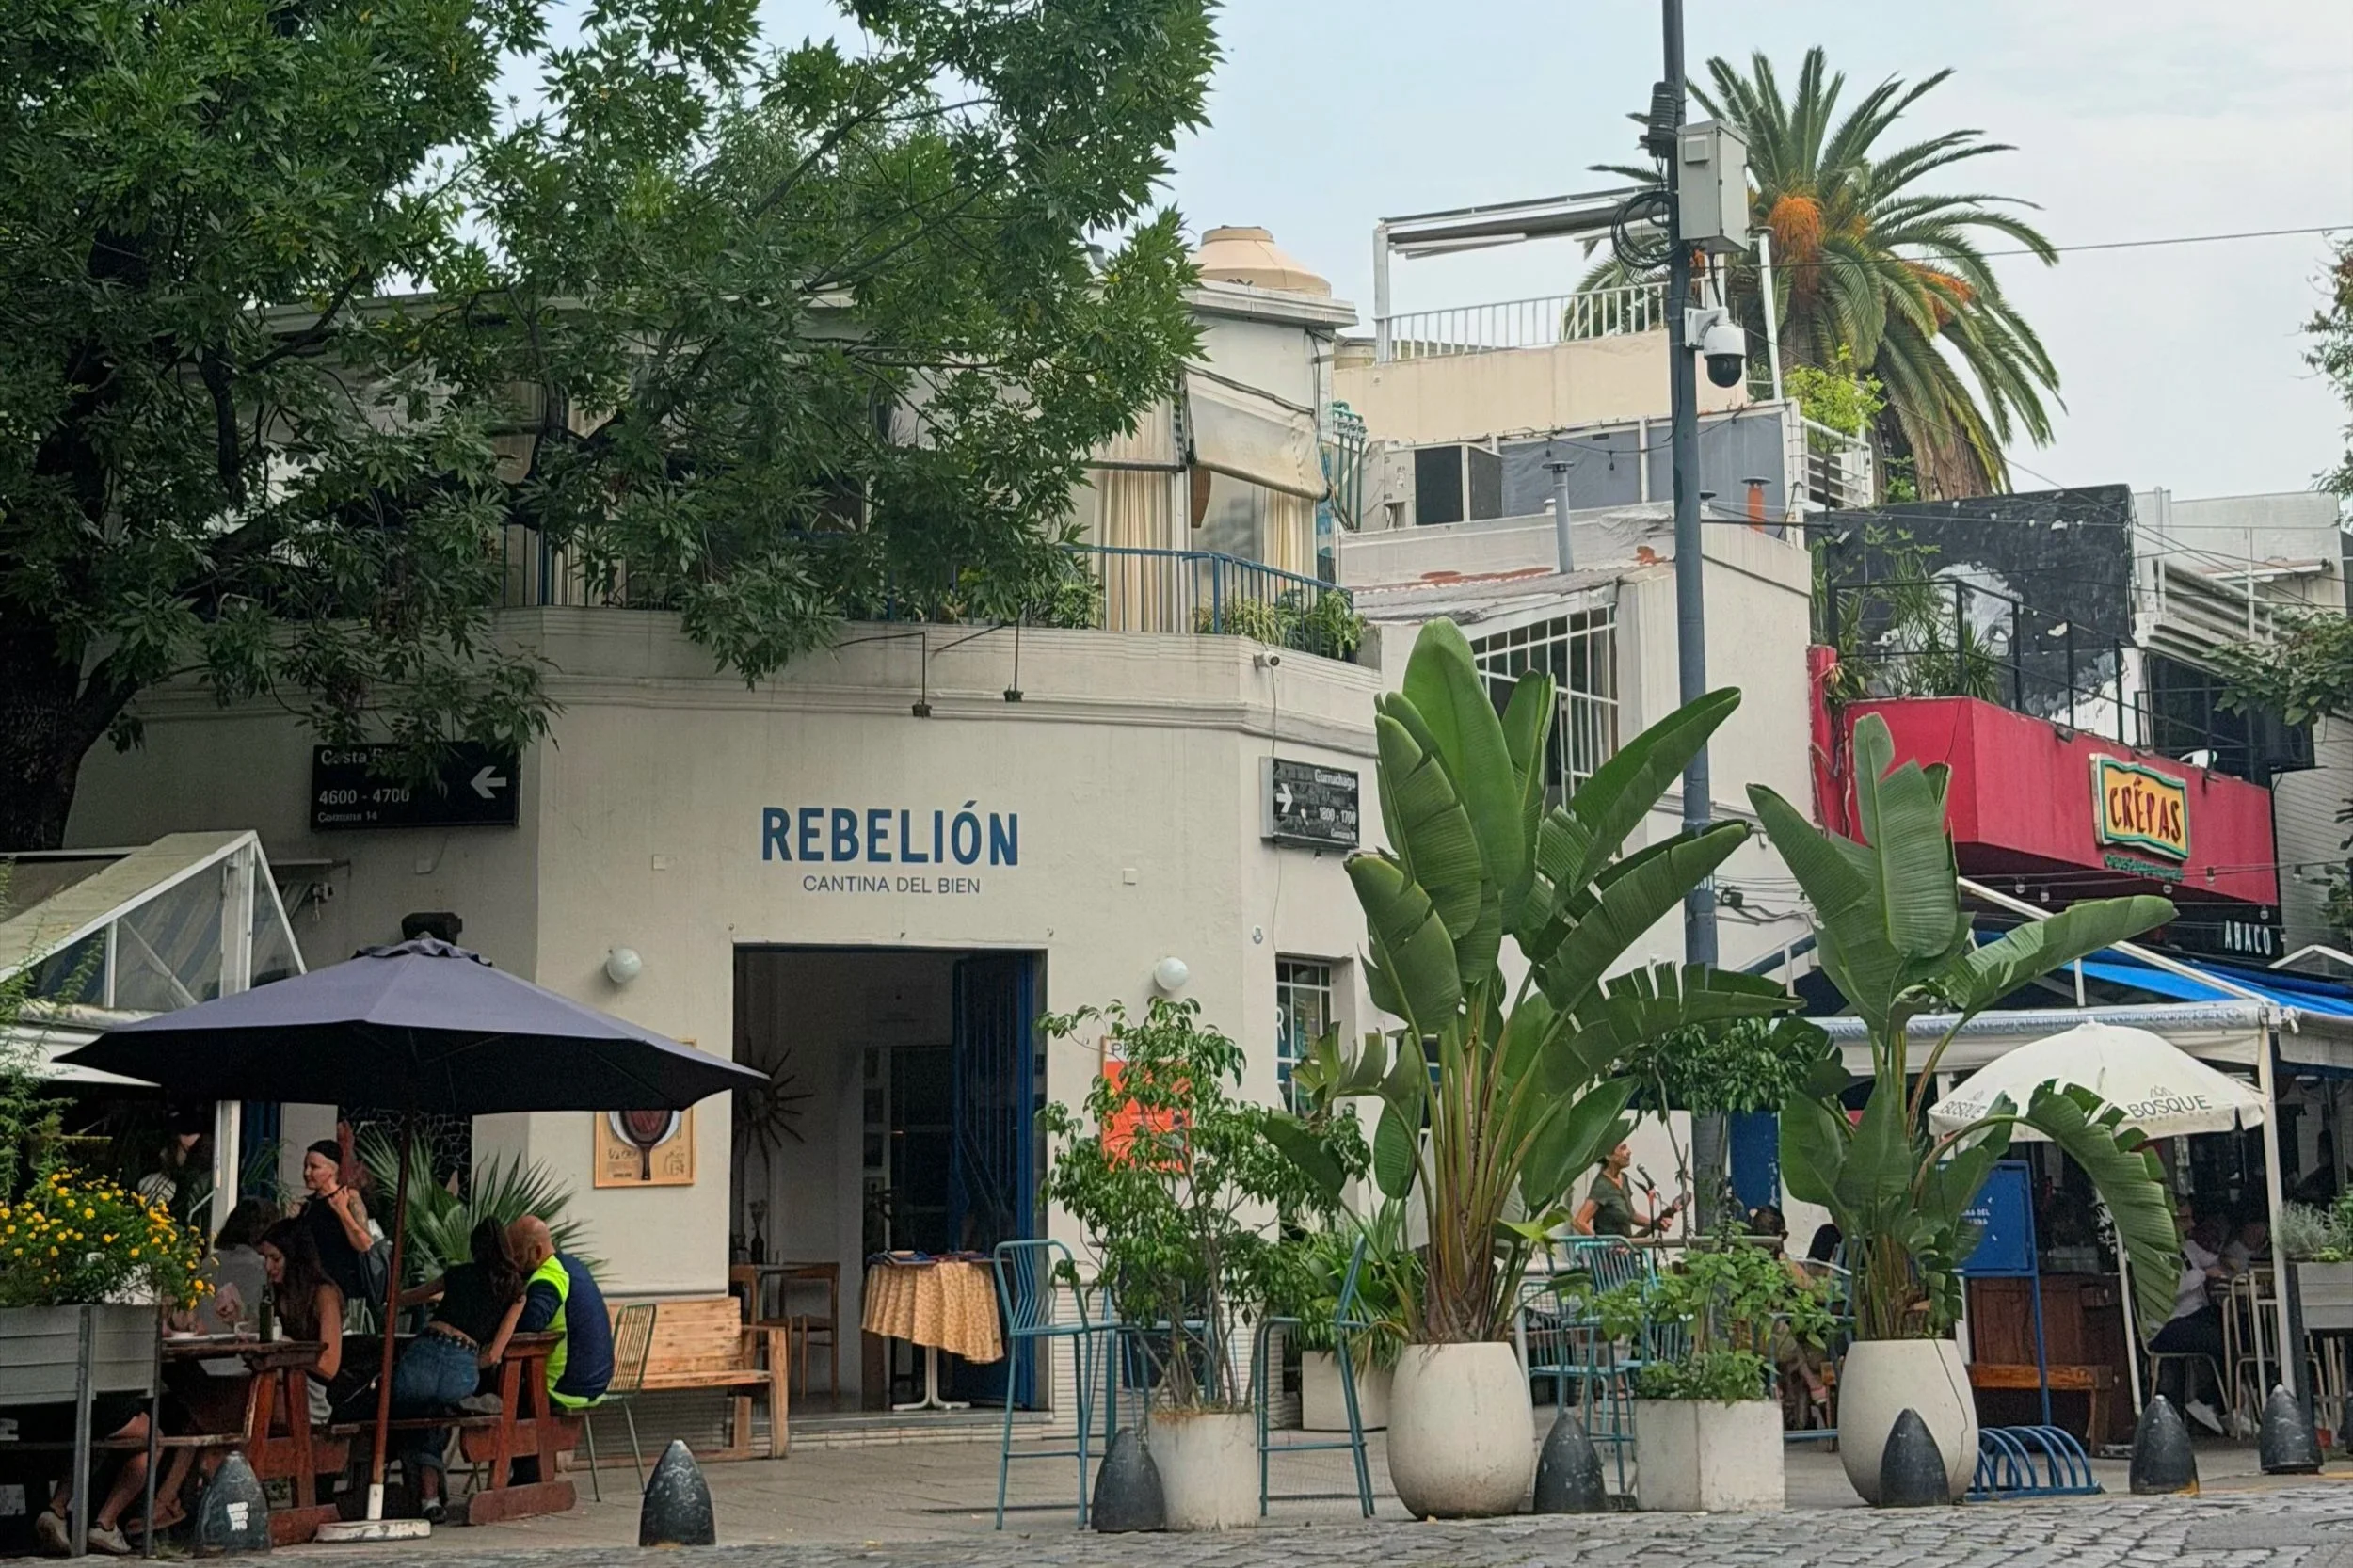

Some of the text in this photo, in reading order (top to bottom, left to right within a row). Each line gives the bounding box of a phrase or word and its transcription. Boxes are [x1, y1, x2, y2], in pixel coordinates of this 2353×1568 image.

[318, 788, 358, 805] 4600
[372, 787, 410, 804] 4700
[2109, 776, 2182, 843] CRÊPAS
[761, 800, 1018, 866] REBELIÓN
[803, 875, 981, 894] CANTINA DEL BIEN
[2224, 920, 2272, 956] ABACO
[2127, 1095, 2213, 1119] BOSQUE
